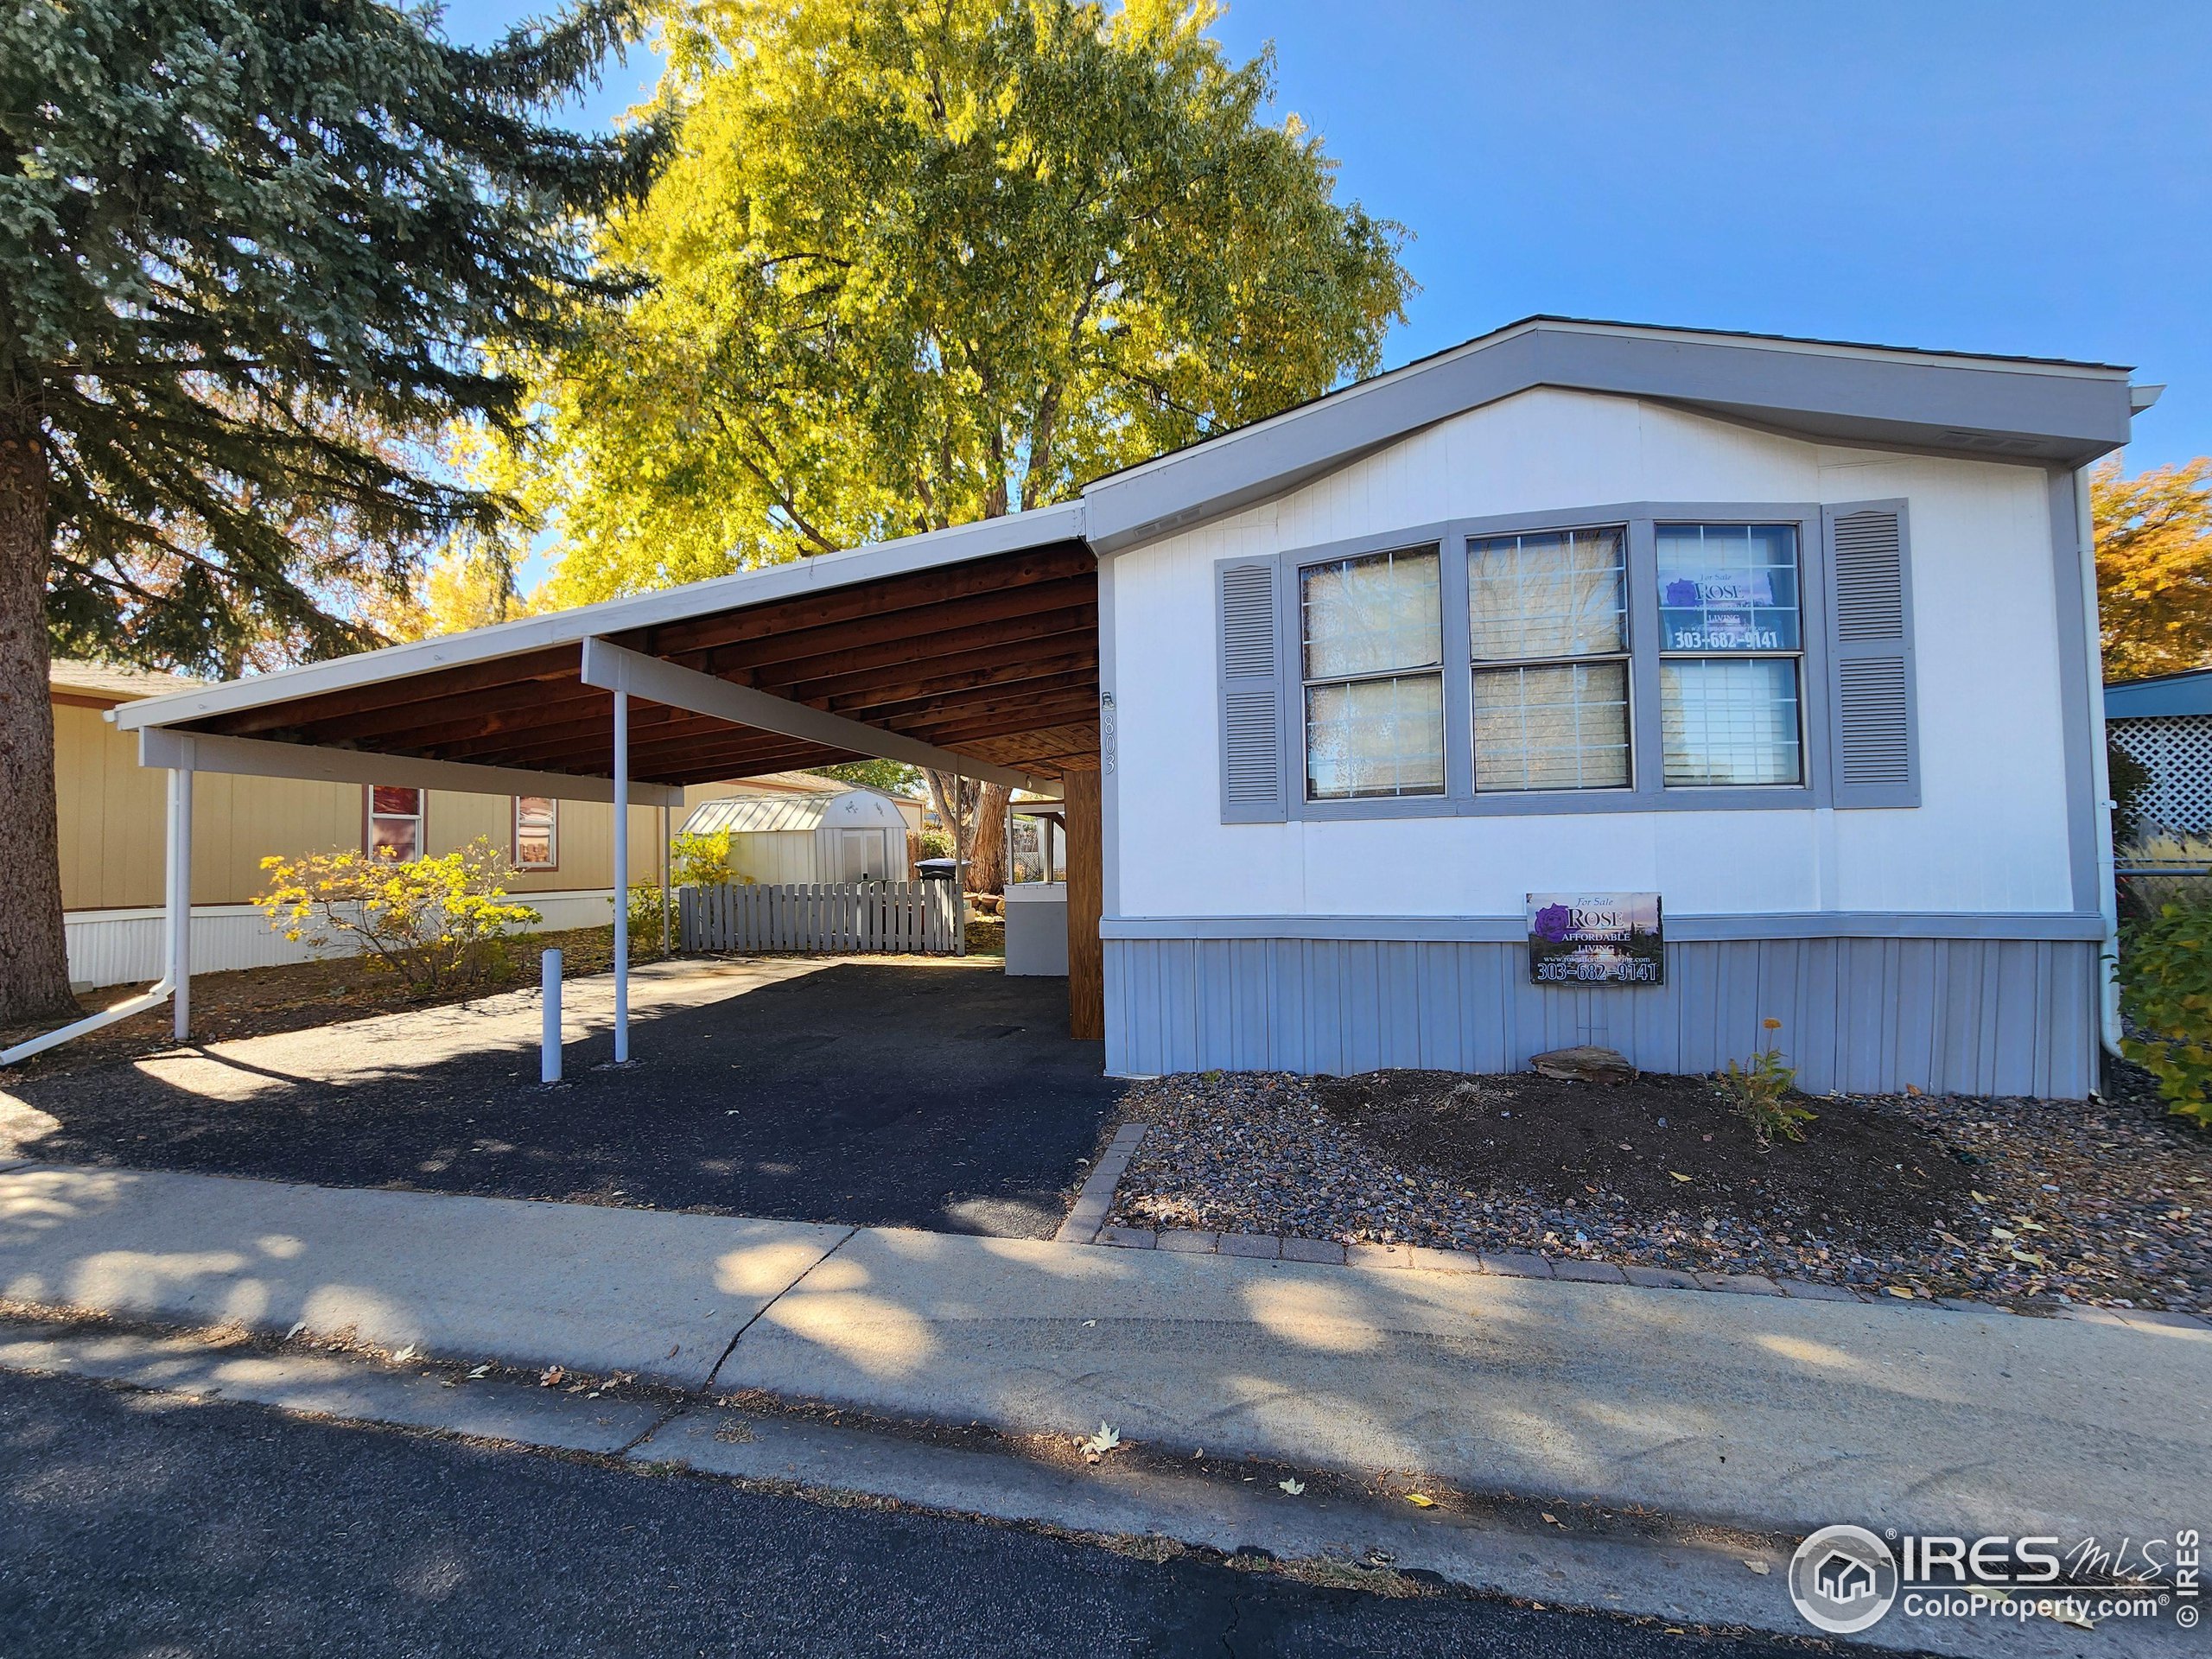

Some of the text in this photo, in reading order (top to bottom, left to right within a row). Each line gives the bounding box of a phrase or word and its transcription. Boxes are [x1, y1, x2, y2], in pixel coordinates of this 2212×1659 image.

[1694, 582, 1745, 600] ROSE
[1707, 614, 1741, 623] LIVING
[1675, 631, 1777, 648] 303-682-9141
[1104, 715, 1116, 774] 803
[1575, 897, 1614, 907] For Sale
[1567, 908, 1624, 928] ROSE
[1562, 933, 1630, 942] AFFORDABLE
[1578, 944, 1615, 953] LIVING
[1537, 963, 1657, 982] 303-682-9141
